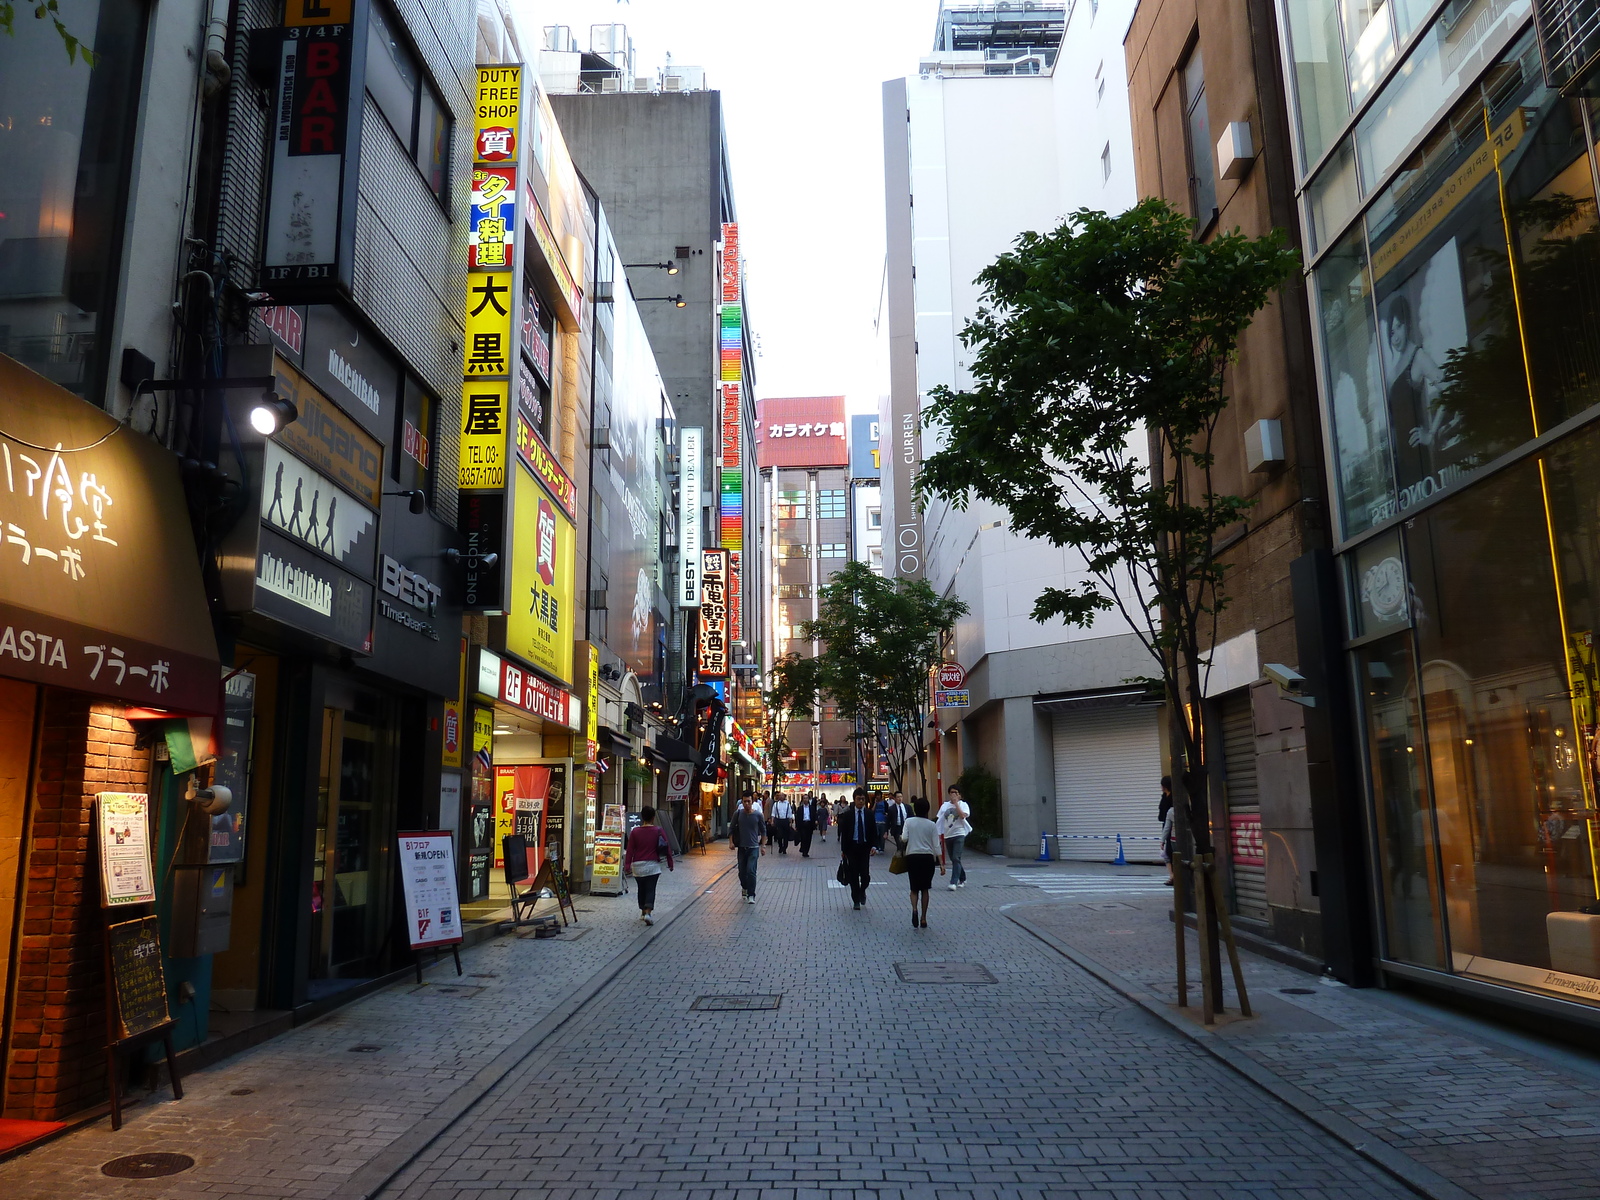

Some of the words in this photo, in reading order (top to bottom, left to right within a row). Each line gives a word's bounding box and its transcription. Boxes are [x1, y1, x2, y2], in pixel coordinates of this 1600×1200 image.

[480, 69, 519, 83] DUTY
[280, 76, 294, 123] WOODSTOCK
[301, 42, 340, 154] BAR
[479, 87, 519, 100] FREE
[478, 105, 518, 118] SHOP
[279, 125, 289, 141] BAR
[480, 130, 512, 156] 質
[473, 170, 488, 182] 3F
[477, 175, 508, 267] タイ料理
[463, 275, 509, 437] 大黒屋
[328, 348, 380, 416] MACHIBAR
[404, 419, 430, 471] BAR
[769, 421, 846, 440] カラオケ館
[903, 413, 915, 465] CURREN
[468, 445, 484, 464] TEL
[485, 445, 499, 464] 03-
[687, 435, 695, 481] DEALER
[460, 466, 503, 486] 3357-1700
[563, 482, 570, 504] 2
[686, 484, 695, 525] WATCH
[467, 532, 479, 569] COIN
[538, 508, 555, 575] 質
[686, 527, 695, 553] THE
[261, 552, 333, 611] MACHIBAR
[382, 554, 442, 618] BEST
[466, 571, 478, 605] ONE
[685, 558, 695, 601] BEST
[529, 580, 559, 634] 大黒屋
[701, 573, 725, 674] 電撃酒場
[364, 641, 372, 651] 2F
[84, 644, 171, 694] ブラーボ
[507, 668, 520, 699] 2F
[940, 672, 961, 682] 消火栓
[405, 841, 430, 851] B1フロア
[418, 908, 430, 919] B1F
[1543, 972, 1599, 994] Ermenegildo
